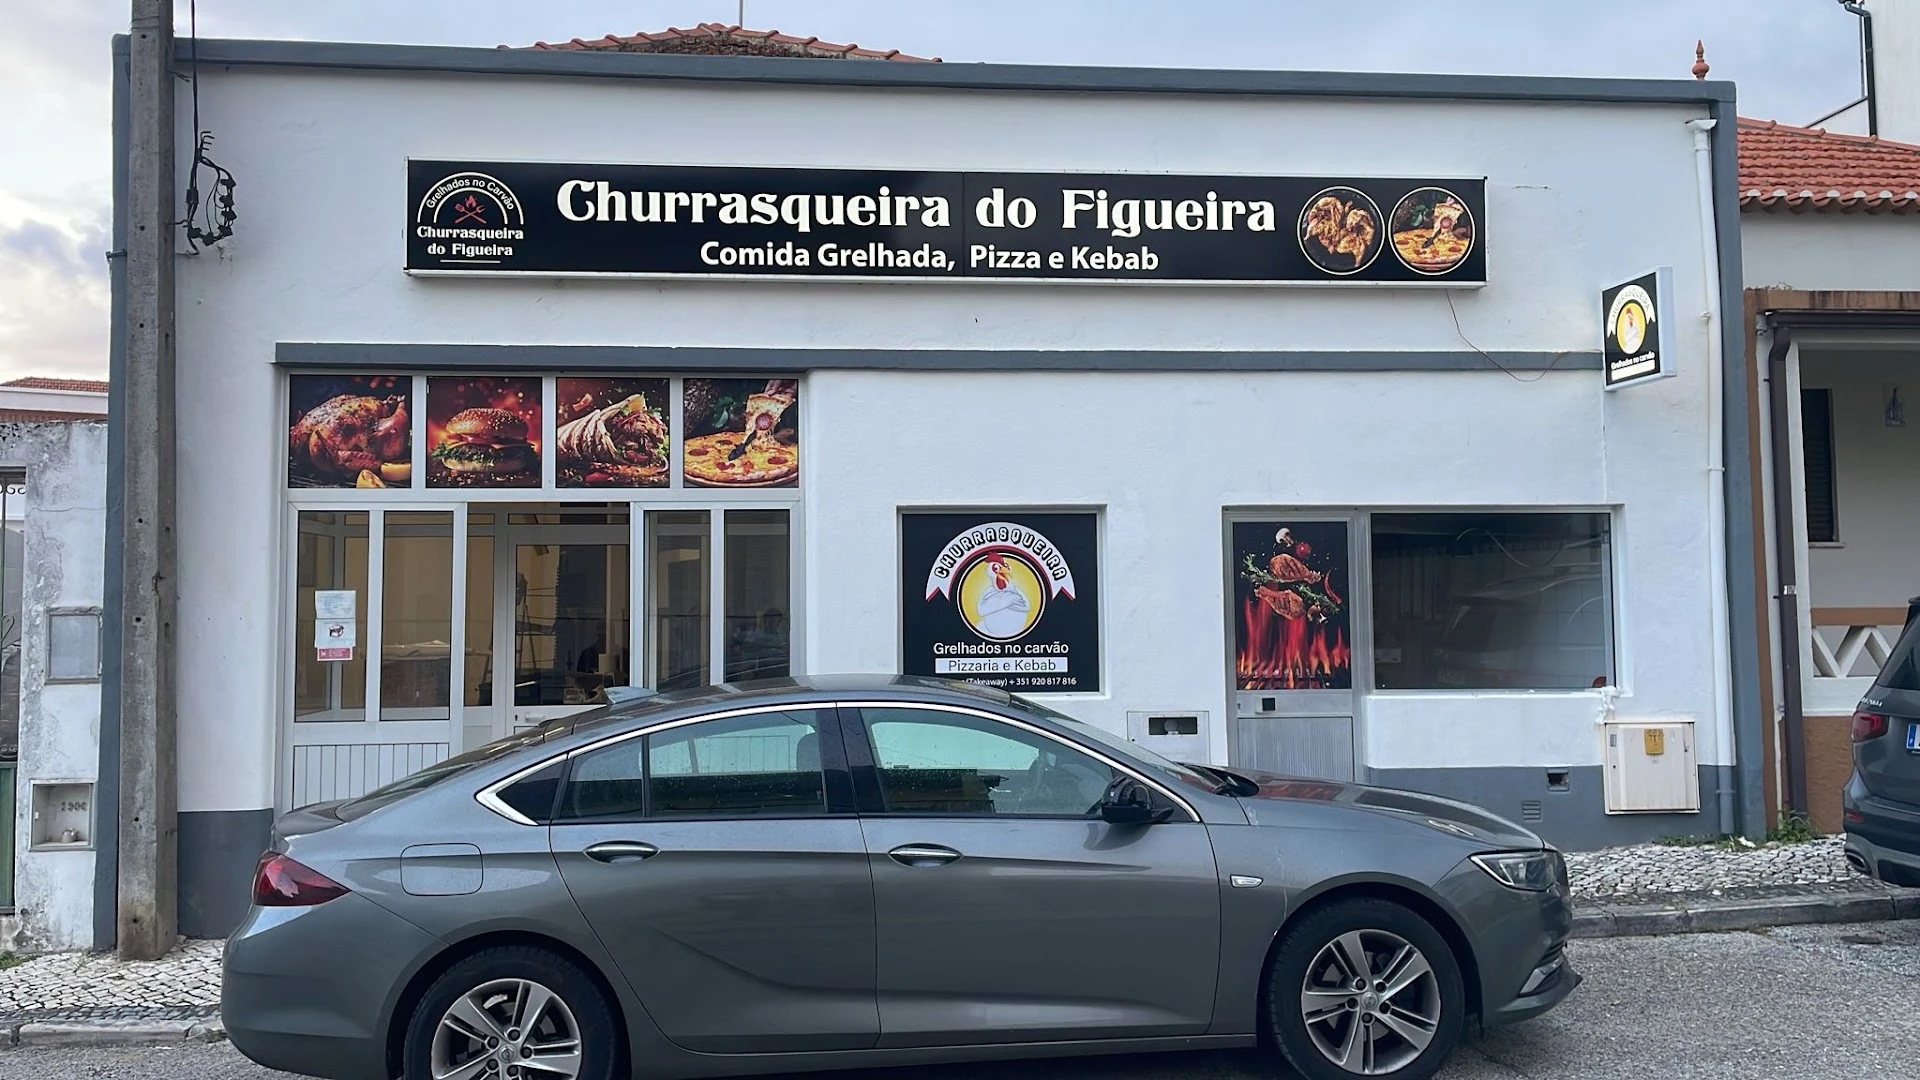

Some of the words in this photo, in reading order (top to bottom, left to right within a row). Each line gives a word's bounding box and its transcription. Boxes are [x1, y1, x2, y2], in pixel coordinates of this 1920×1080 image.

[426, 179, 470, 208] Grelhados
[472, 179, 485, 188] no
[487, 182, 514, 210] Carvão
[557, 180, 951, 233] Churrasqueira
[976, 187, 1036, 229] do
[1062, 189, 1275, 238] Figueira
[416, 225, 524, 240] Churrasqueira
[427, 243, 446, 255] do
[451, 243, 513, 257] Figueira
[701, 241, 810, 267] Comida
[817, 242, 956, 272] Grelhada,
[970, 244, 1041, 269] Pizza
[1048, 252, 1065, 269] e
[1071, 245, 1159, 270] Kebab
[934, 527, 1068, 581] CHURRASQUEIRA
[933, 642, 1002, 655] Grelhados
[1005, 644, 1021, 654] no
[1024, 641, 1069, 654] carvão
[948, 660, 999, 672] Pizzaria
[1003, 662, 1011, 671] e
[1015, 659, 1057, 671] Kebab
[1016, 677, 1030, 686] 351
[1031, 677, 1046, 686] 920
[1047, 677, 1060, 686] 817
[1062, 677, 1077, 685] 816
